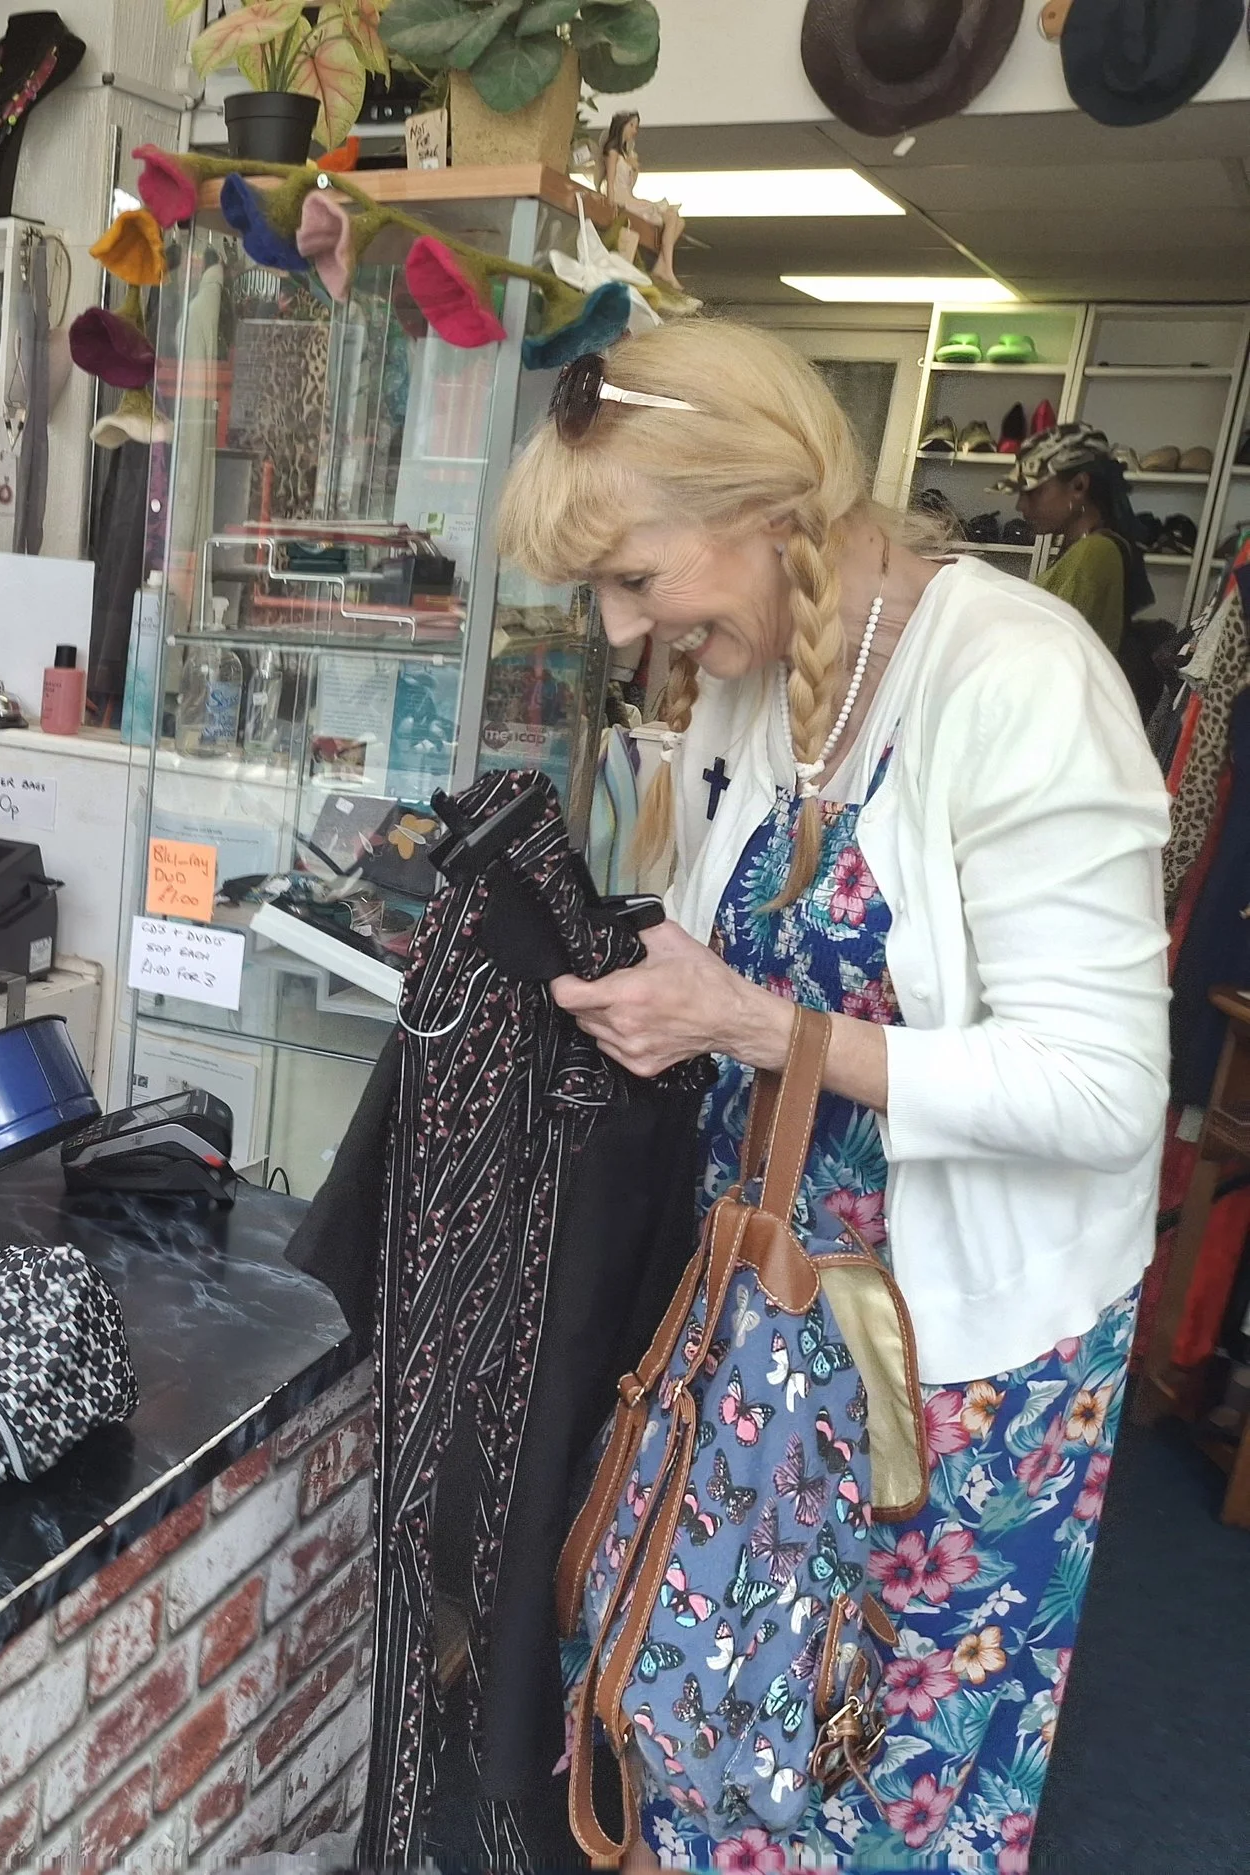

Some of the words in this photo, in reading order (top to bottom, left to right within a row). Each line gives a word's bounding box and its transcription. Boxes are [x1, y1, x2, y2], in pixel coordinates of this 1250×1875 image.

[22, 779, 46, 792] BAGS
[154, 867, 187, 884] DVD
[179, 945, 211, 962] EACH
[177, 967, 201, 984] FOR
[203, 971, 217, 988] 3
